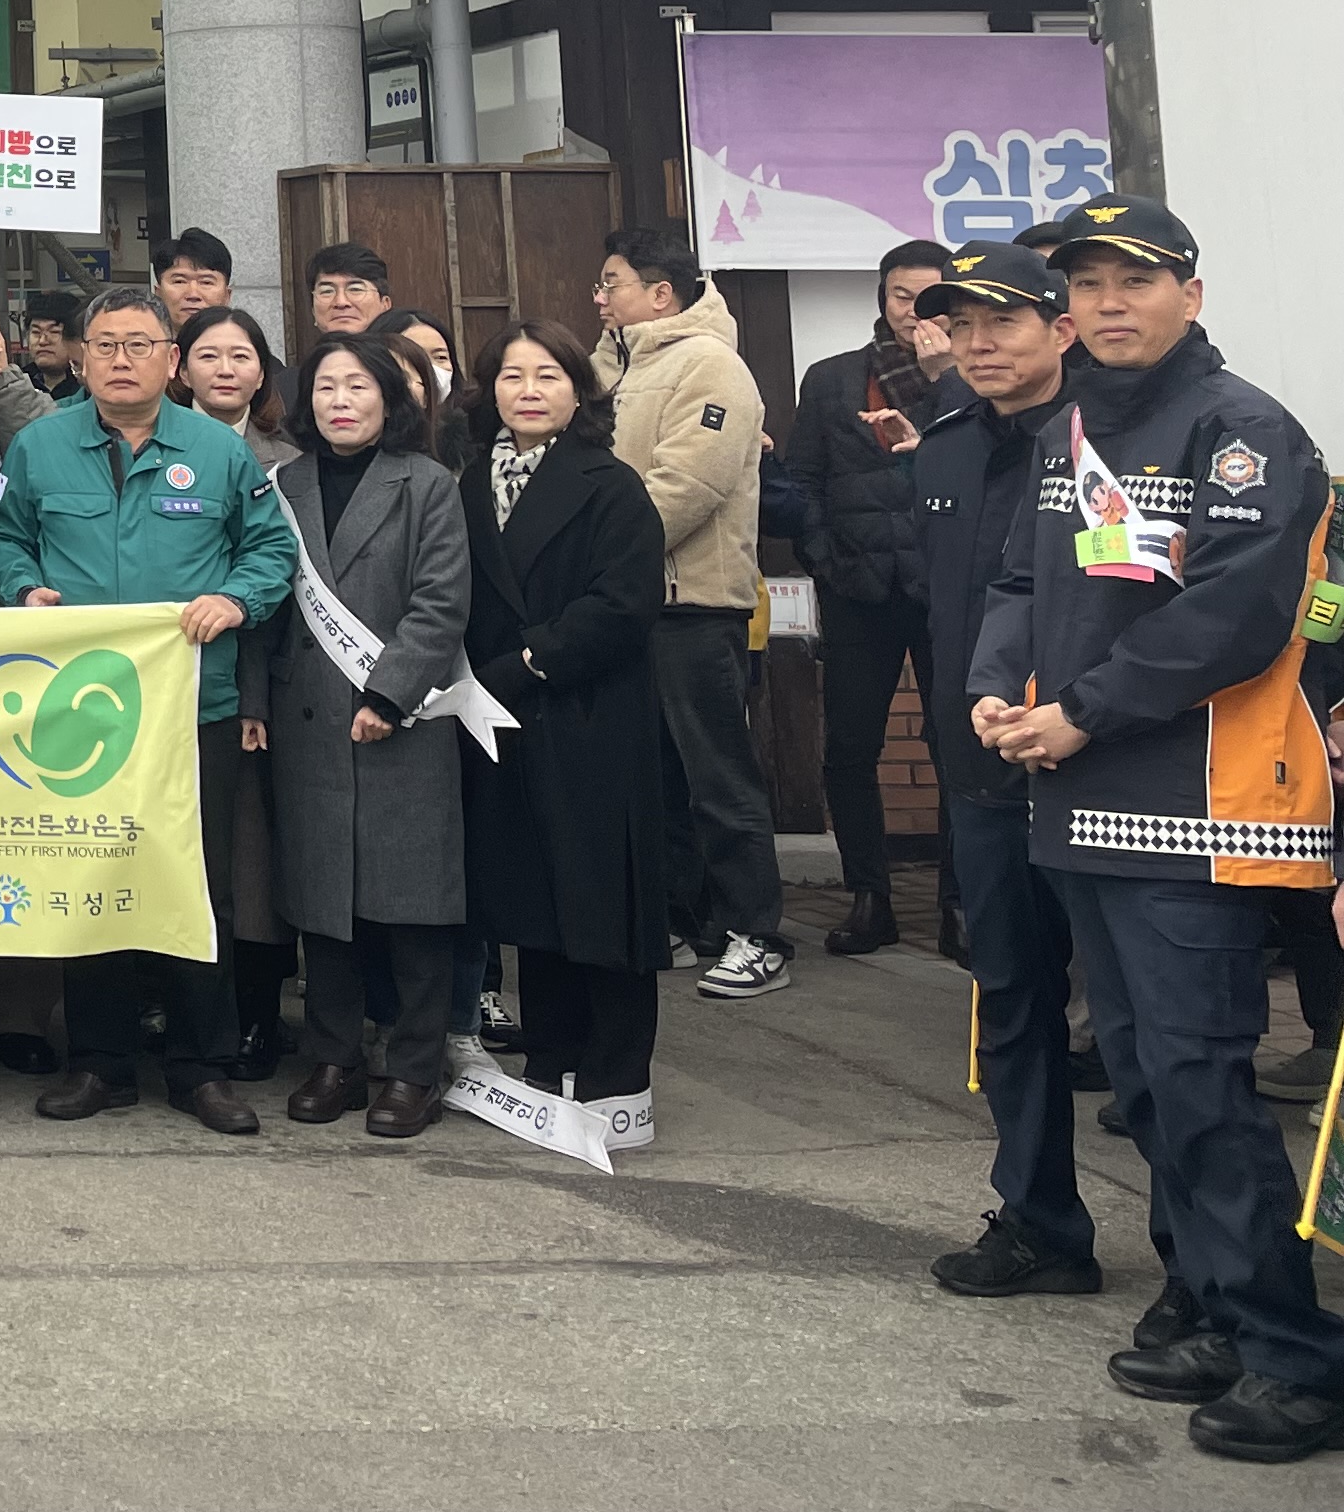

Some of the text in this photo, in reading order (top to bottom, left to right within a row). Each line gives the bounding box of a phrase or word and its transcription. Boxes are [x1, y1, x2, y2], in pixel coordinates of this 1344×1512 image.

[31, 844, 64, 858] FIRST
[67, 845, 137, 860] MOVEMENT
[47, 888, 135, 916] 곡성군
[483, 1086, 535, 1120] 캠페인
